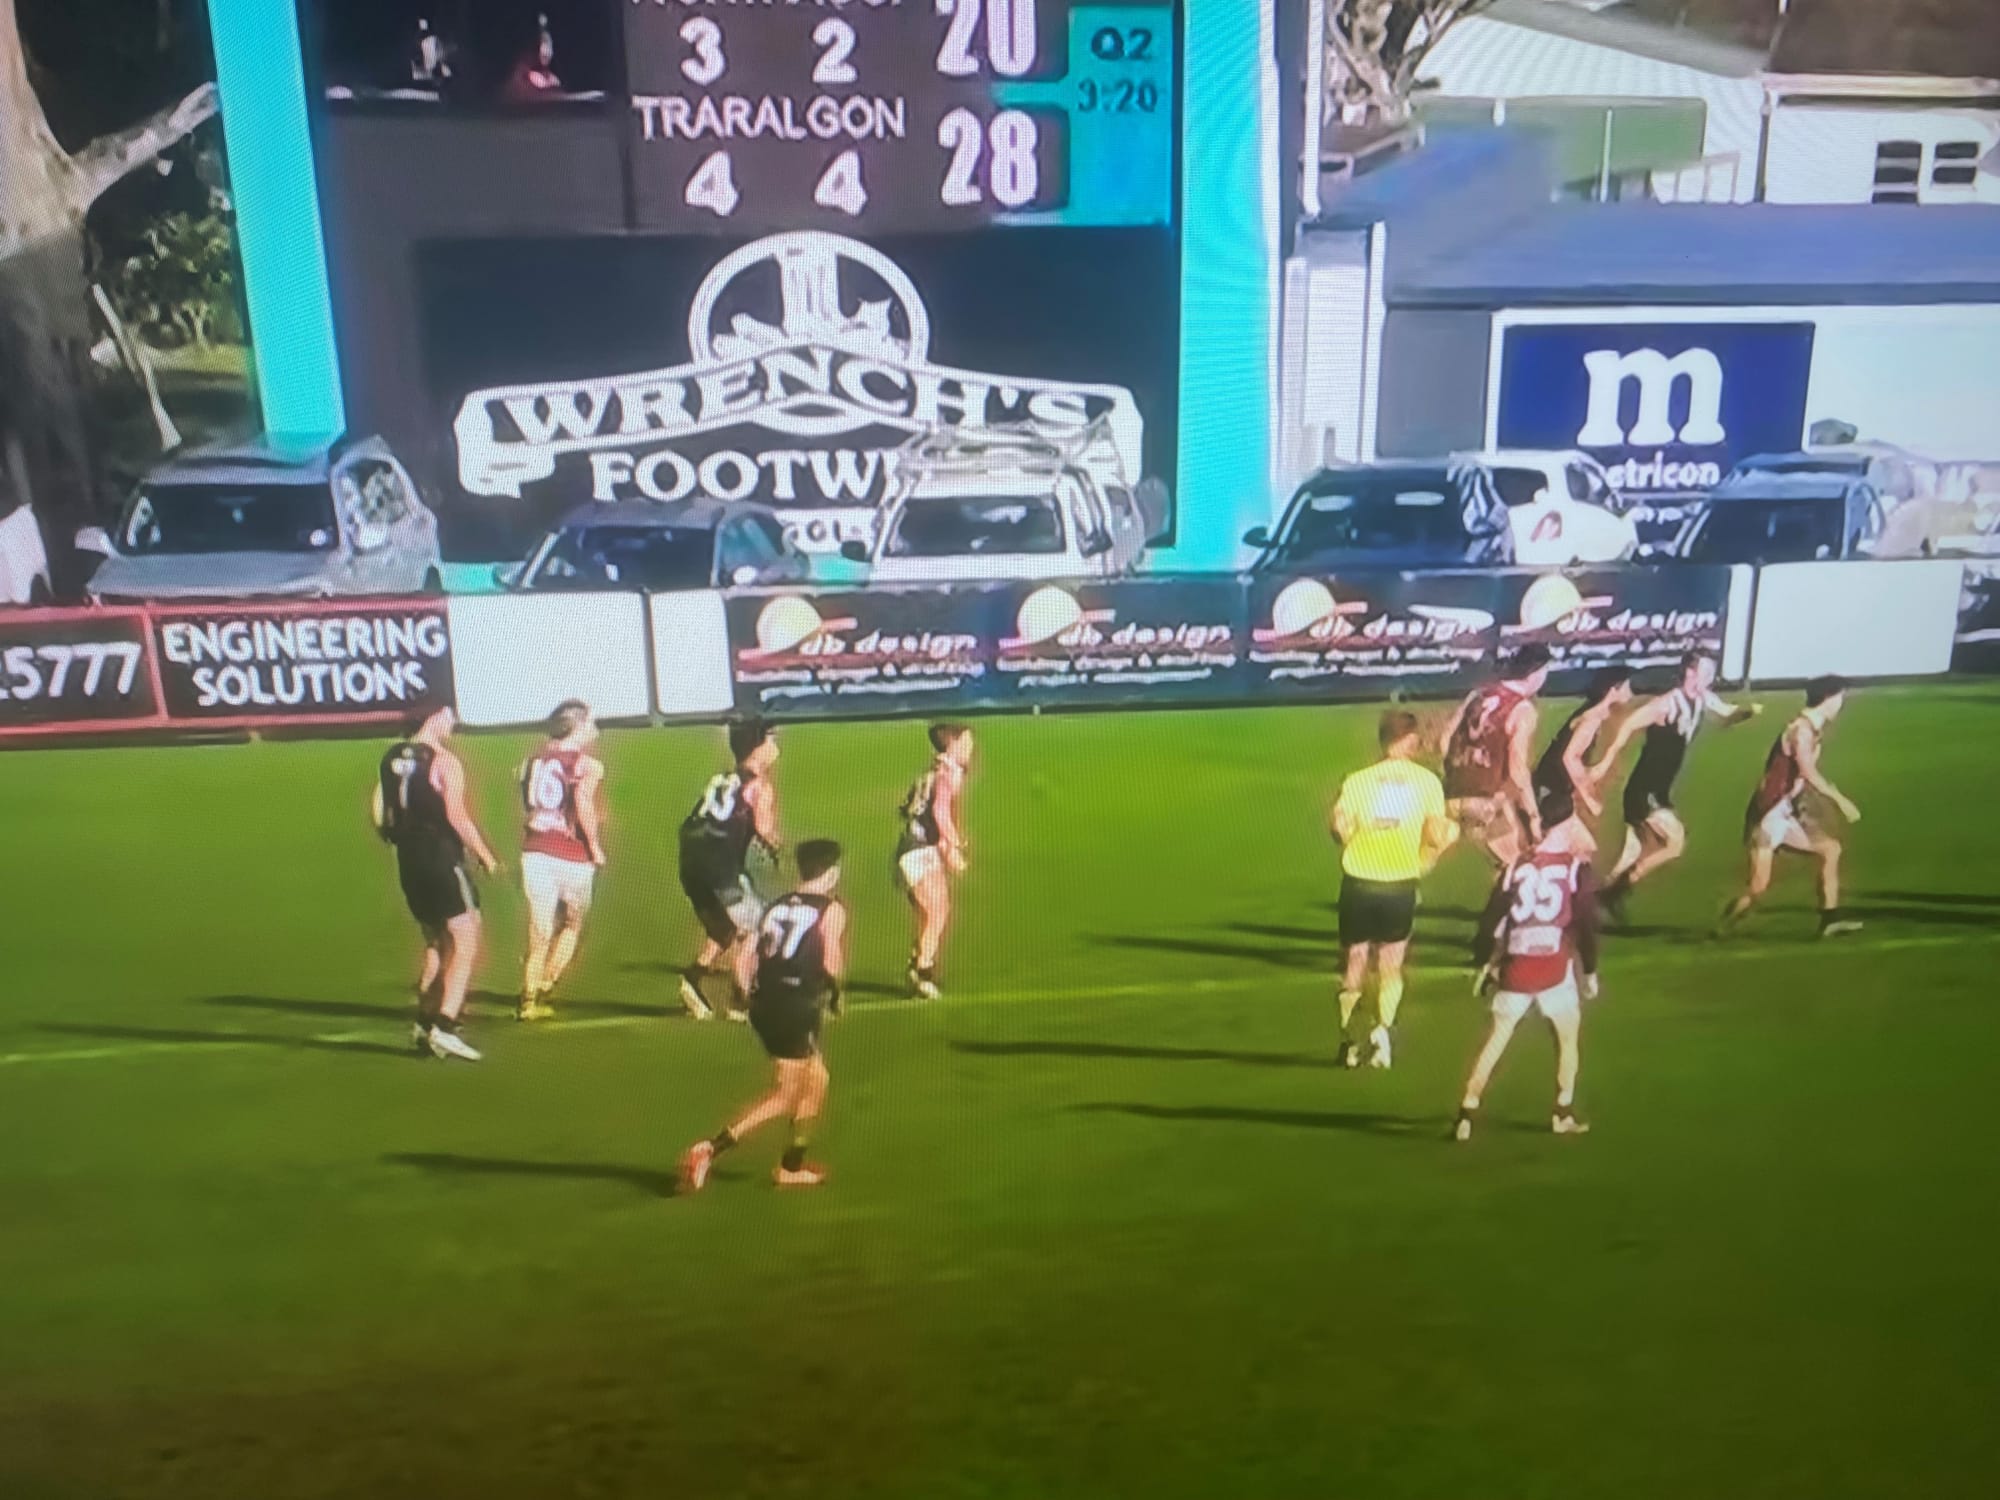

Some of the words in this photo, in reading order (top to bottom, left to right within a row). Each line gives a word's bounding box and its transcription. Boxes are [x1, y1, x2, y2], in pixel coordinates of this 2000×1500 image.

[681, 17, 726, 85] 3
[812, 17, 858, 83] 2
[936, 0, 1037, 75] 20
[1090, 27, 1153, 60] Q2
[631, 95, 905, 141] TRARALGON
[685, 151, 739, 216] 4
[814, 151, 867, 216] 4
[938, 108, 1038, 206] 28
[497, 353, 1091, 445] WRENCH'S
[1577, 347, 1726, 446] m
[590, 450, 898, 502] FOOTW
[1604, 450, 1720, 488] etricon
[162, 616, 447, 664] ENGINEERING
[0, 643, 141, 700] 5777
[192, 660, 427, 706] SOLUTIONS
[1511, 862, 1568, 922] 35
